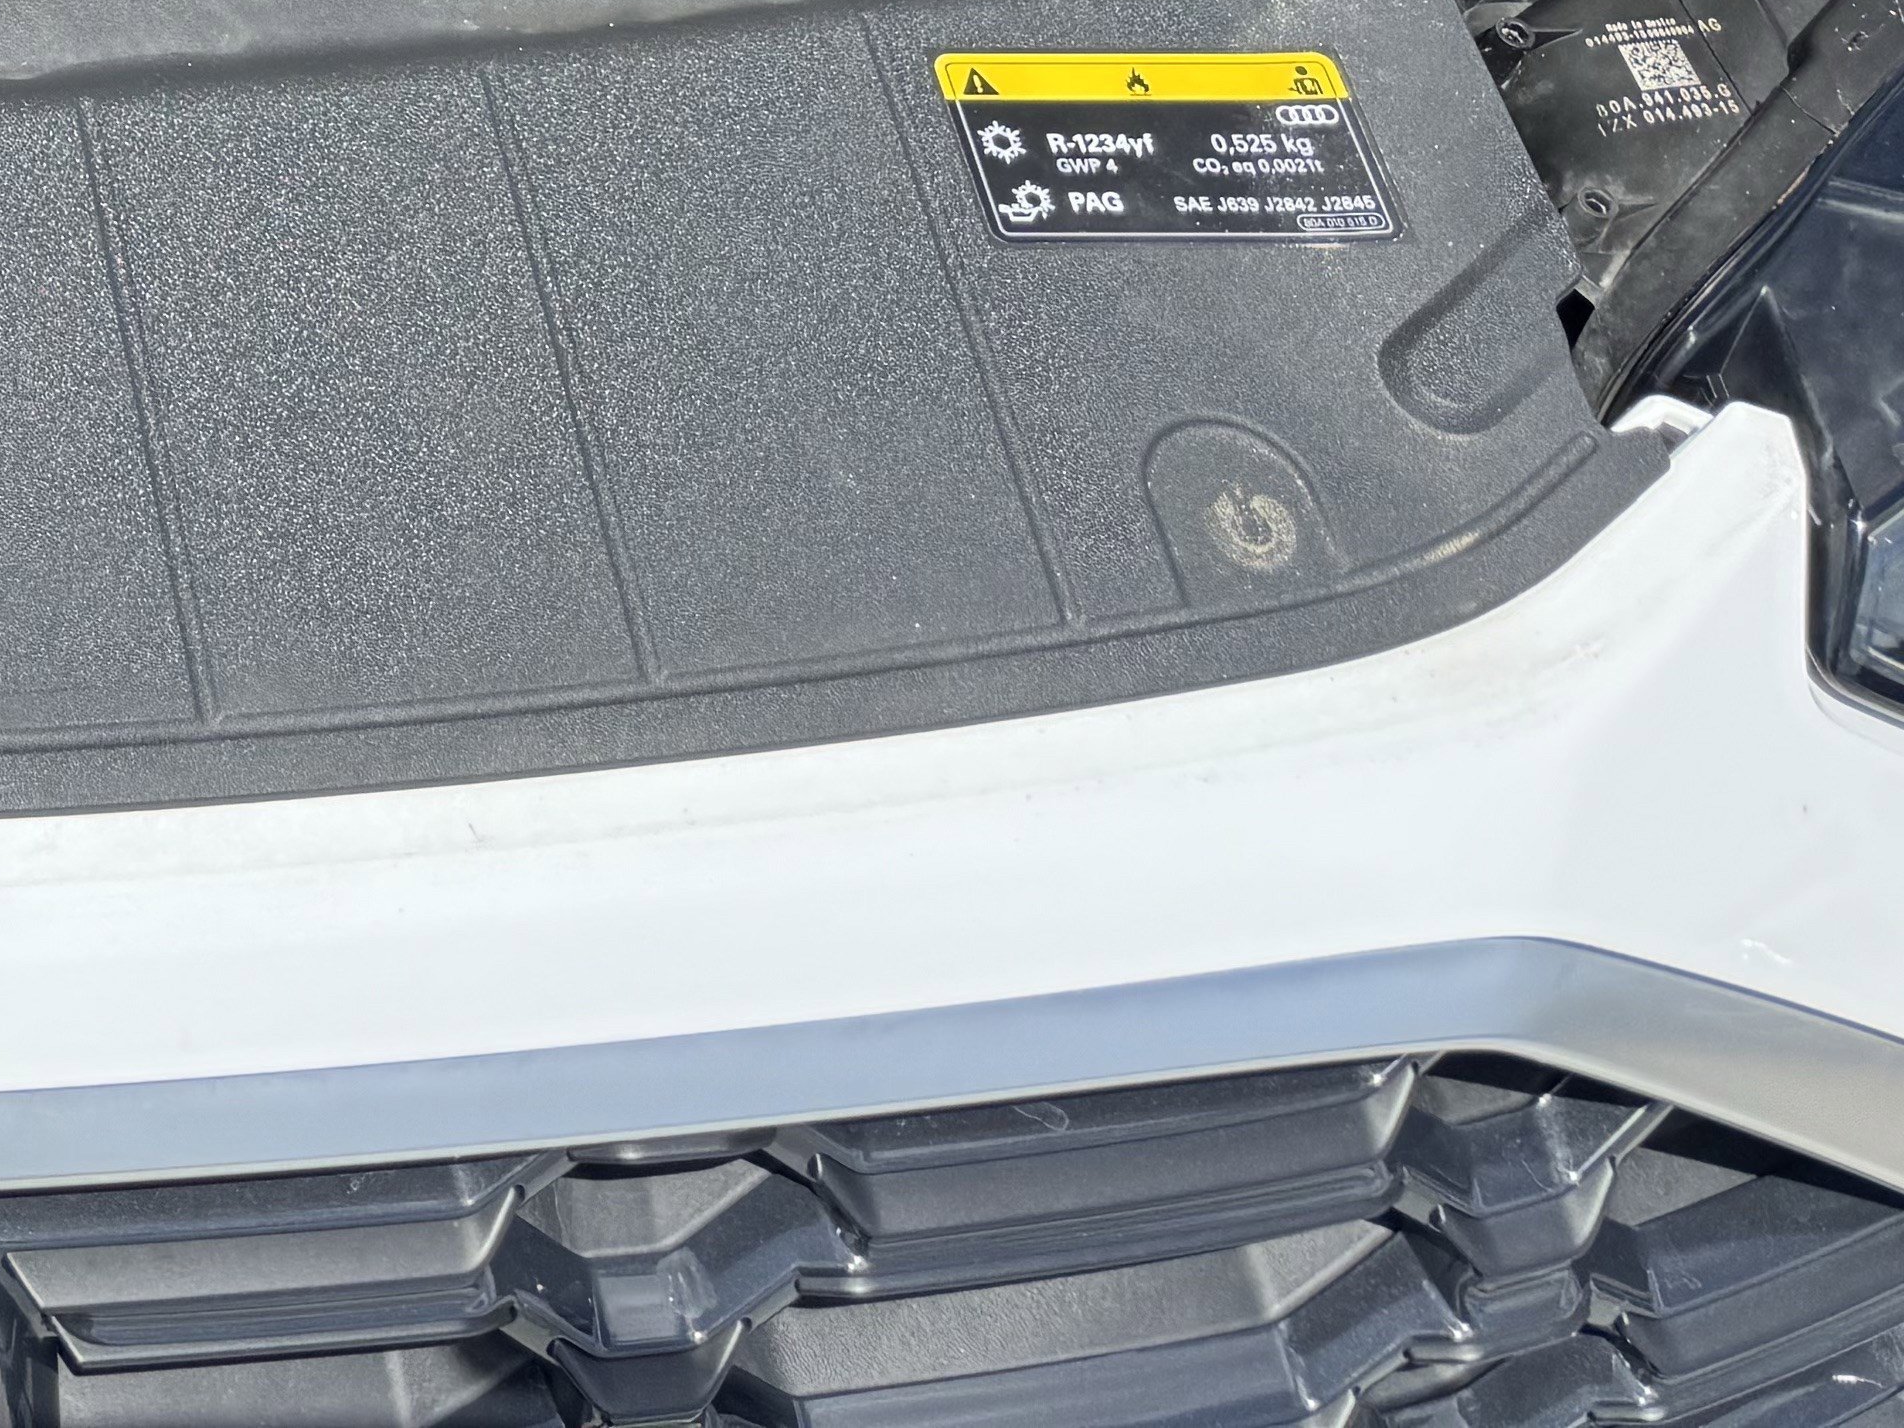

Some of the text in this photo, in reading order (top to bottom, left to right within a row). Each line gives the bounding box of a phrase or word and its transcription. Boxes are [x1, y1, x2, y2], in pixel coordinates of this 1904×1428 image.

[1697, 17, 1722, 33] AG
[1046, 133, 1315, 159] R-1234yf 0,525 kg
[1056, 158, 1102, 175] GWP
[1106, 159, 1119, 175] 4
[1232, 160, 1255, 177] eq
[1067, 191, 1377, 215] PAG SAE J639 J2842 J2845
